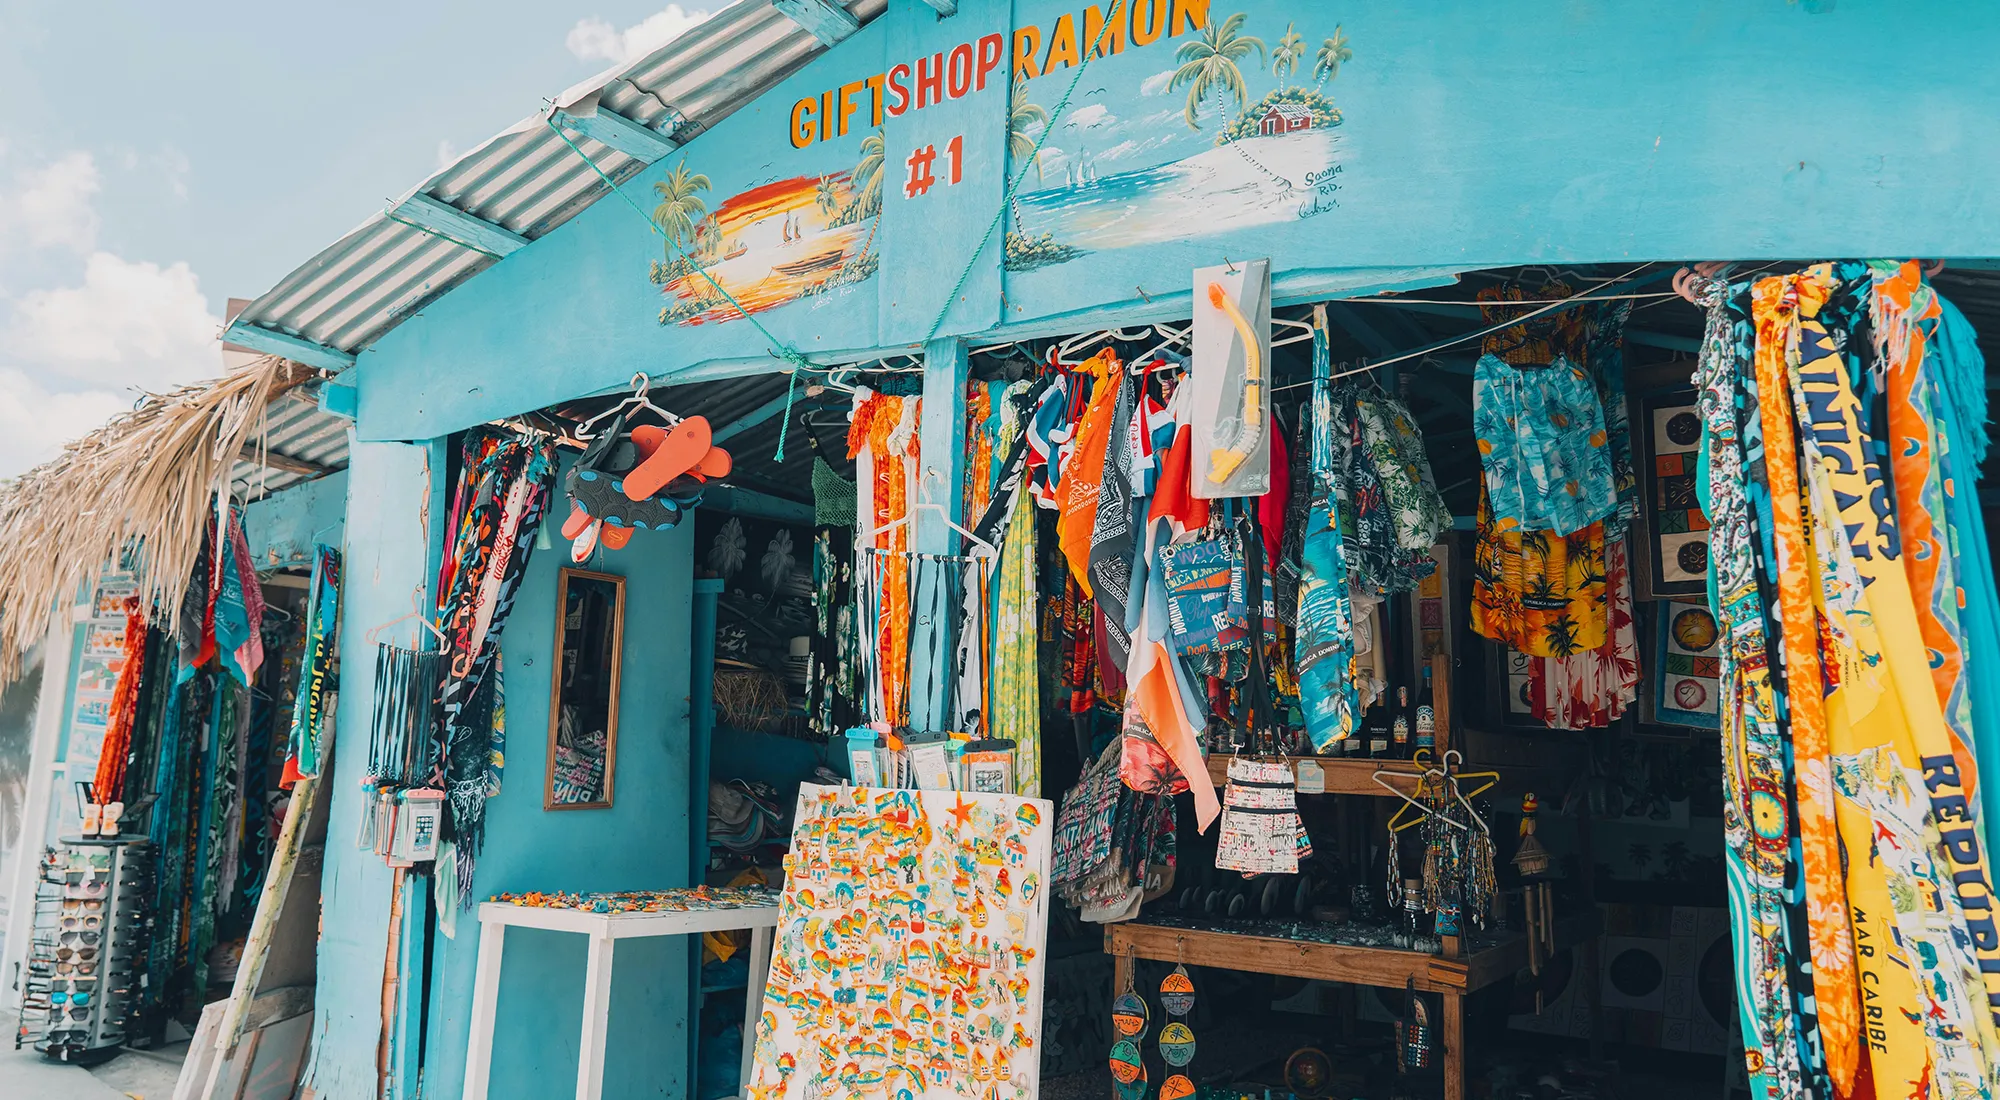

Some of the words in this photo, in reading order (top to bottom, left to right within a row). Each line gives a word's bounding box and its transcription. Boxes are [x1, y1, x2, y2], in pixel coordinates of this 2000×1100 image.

[790, 73, 884, 149] GIFT
[884, 32, 1004, 118] SHOP
[1012, 0, 1208, 82] RAMON
[903, 135, 963, 200] #1
[1304, 165, 1343, 187] Saona
[1319, 183, 1342, 196] R.D.
[1853, 906, 1874, 958] MAR
[1862, 971, 1887, 1054] CARIBE
